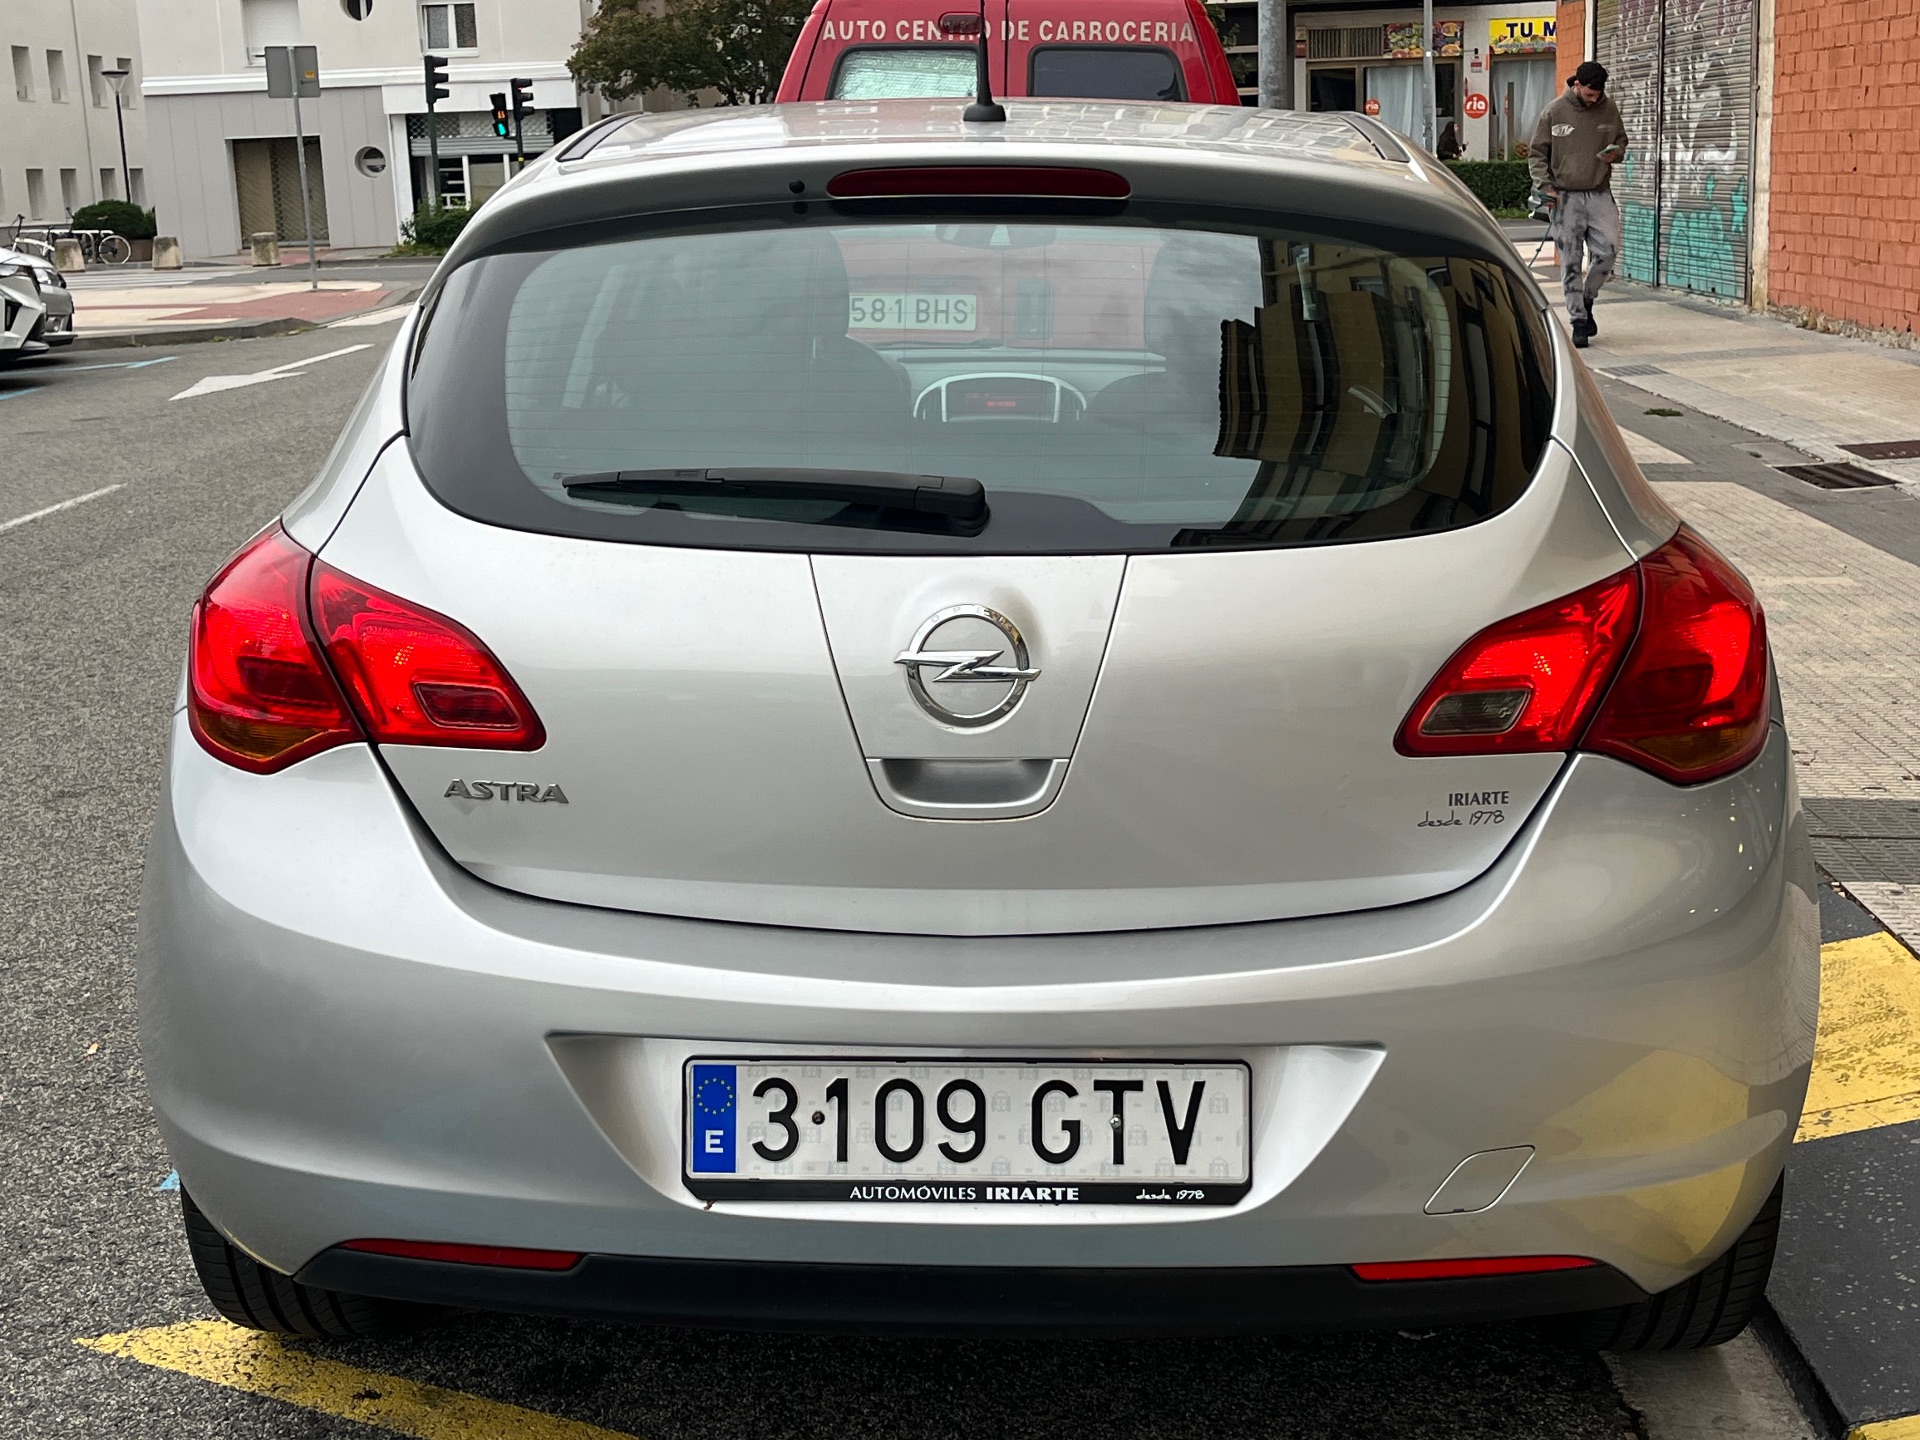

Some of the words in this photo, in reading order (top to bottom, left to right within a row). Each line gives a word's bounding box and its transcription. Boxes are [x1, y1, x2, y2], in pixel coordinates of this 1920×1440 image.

[822, 20, 887, 41] AUTO
[895, 20, 992, 41] CENO
[1001, 20, 1030, 41] DE
[1039, 20, 1194, 42] CARROCERIA
[1505, 22, 1534, 38] TU
[1465, 96, 1486, 111] ria
[915, 299, 968, 325] BHS
[443, 779, 570, 804] ASTRA
[1448, 791, 1510, 807] IRIARTE
[1417, 810, 1463, 828] desde
[1469, 810, 1505, 826] 1978
[751, 1077, 987, 1165] 3109
[1031, 1079, 1207, 1166] GTV
[705, 1129, 724, 1154] E
[849, 1185, 977, 1200] AUTOMÓVILES
[985, 1186, 1080, 1201] IRIARTE
[1135, 1183, 1172, 1200] desde
[1176, 1189, 1205, 1200] 1978
